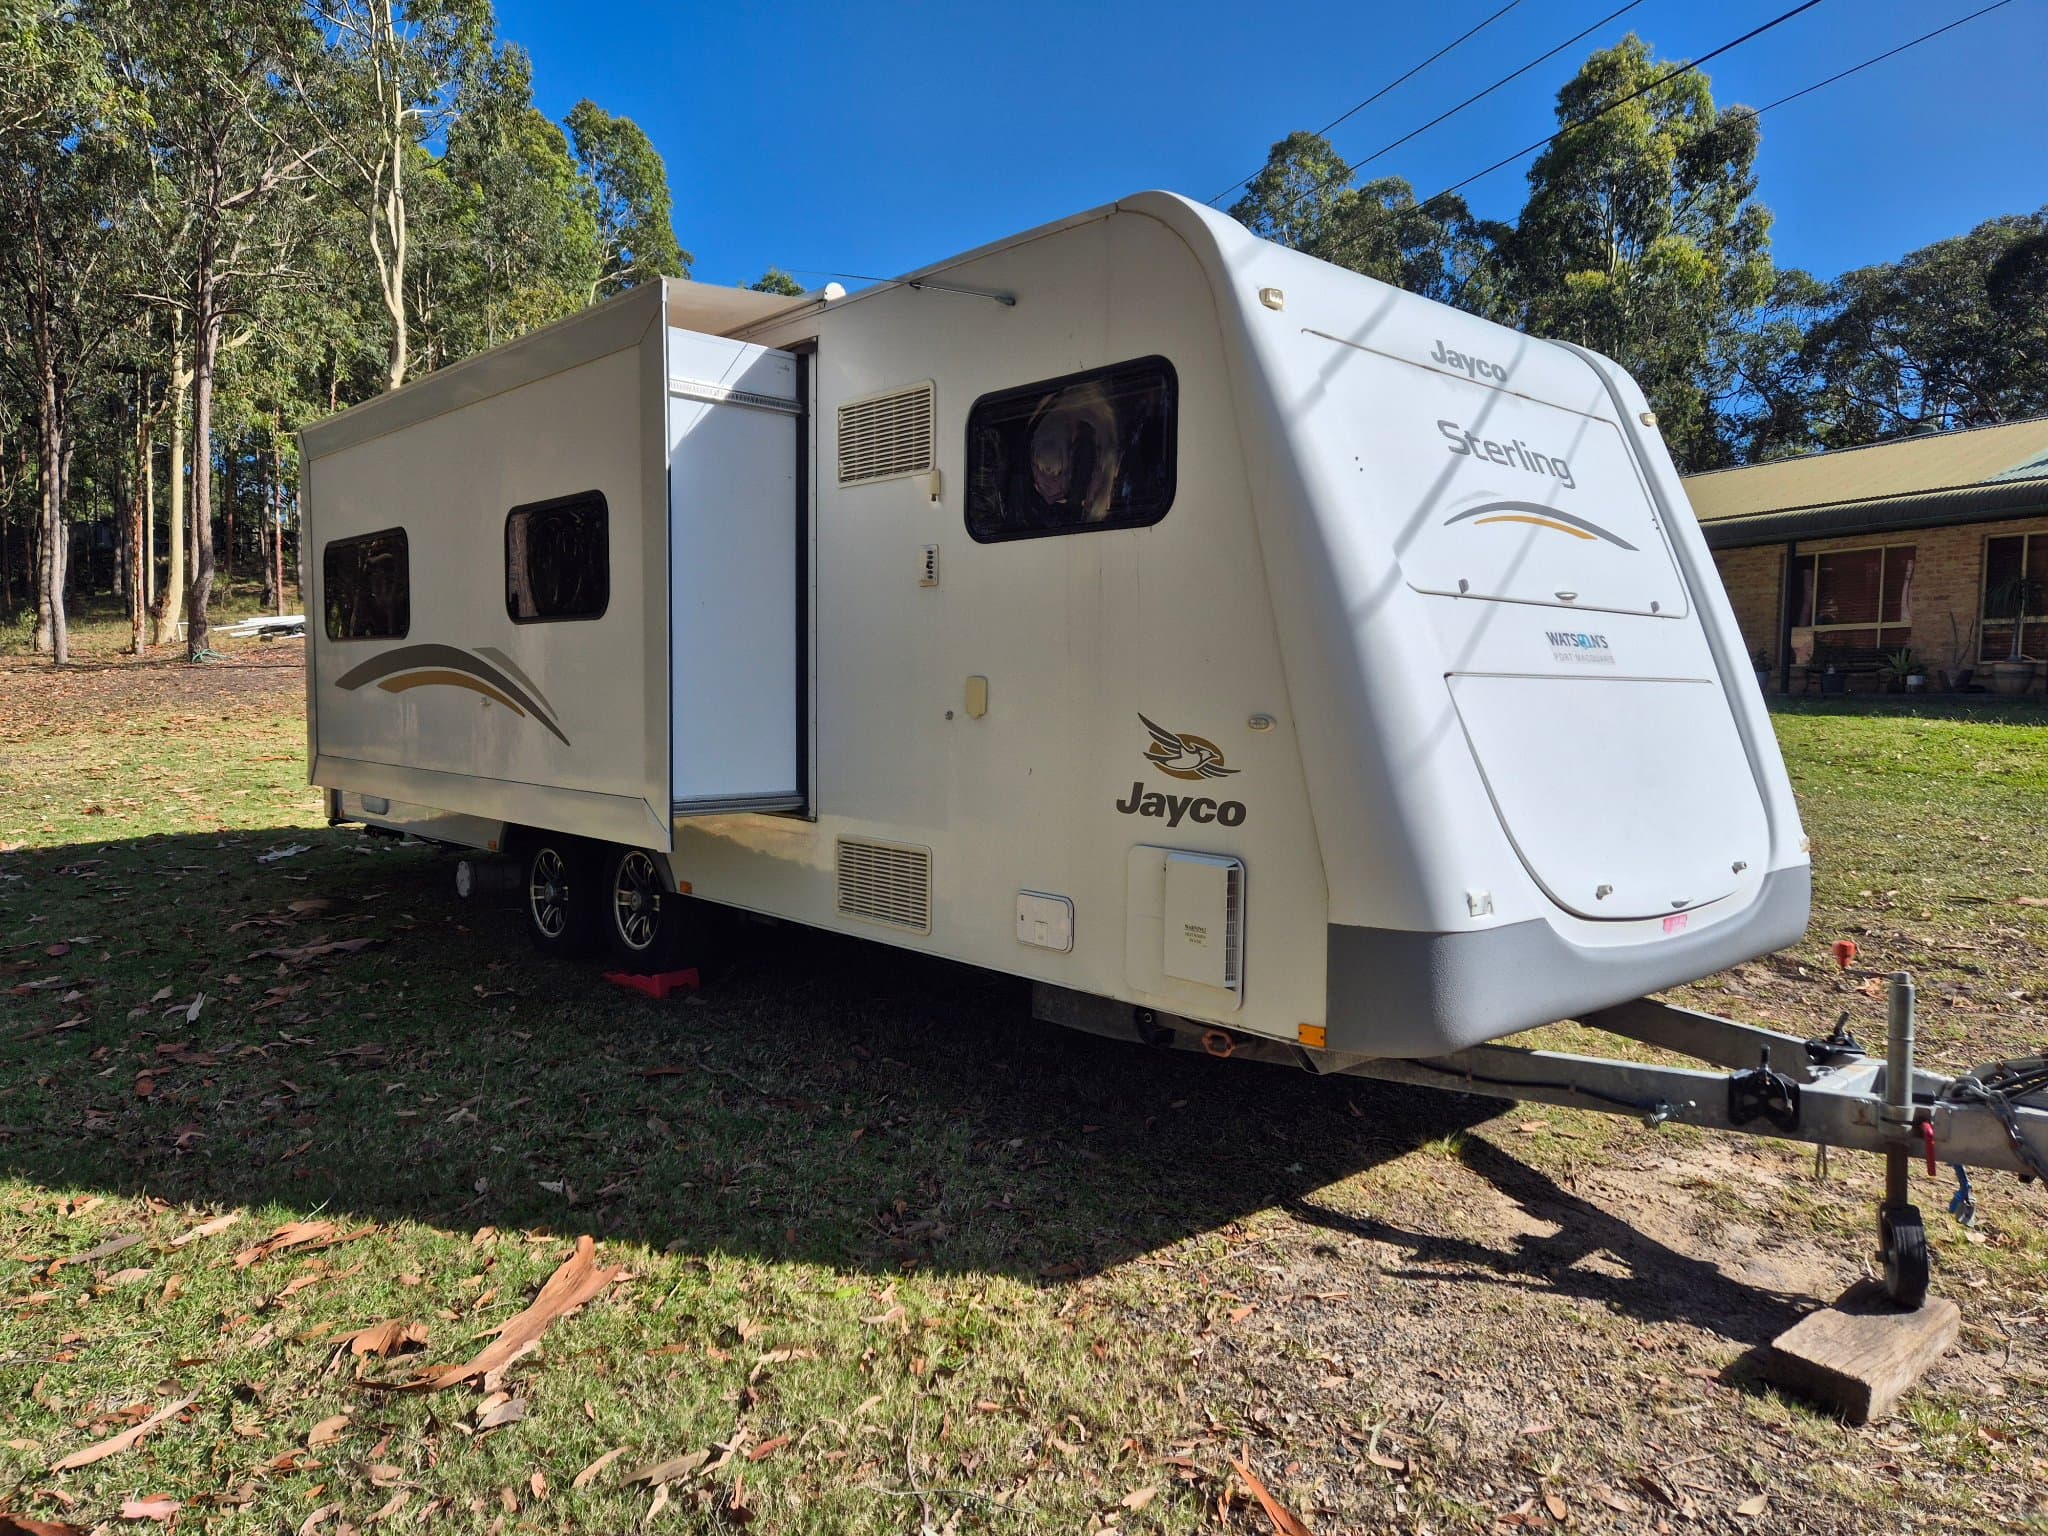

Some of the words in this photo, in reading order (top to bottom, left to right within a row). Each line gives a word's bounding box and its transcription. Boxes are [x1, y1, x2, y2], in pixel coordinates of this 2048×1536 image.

[1430, 339, 1508, 383] Jayco
[1437, 419, 1576, 490] Sterling
[1116, 781, 1247, 828] Jayco
